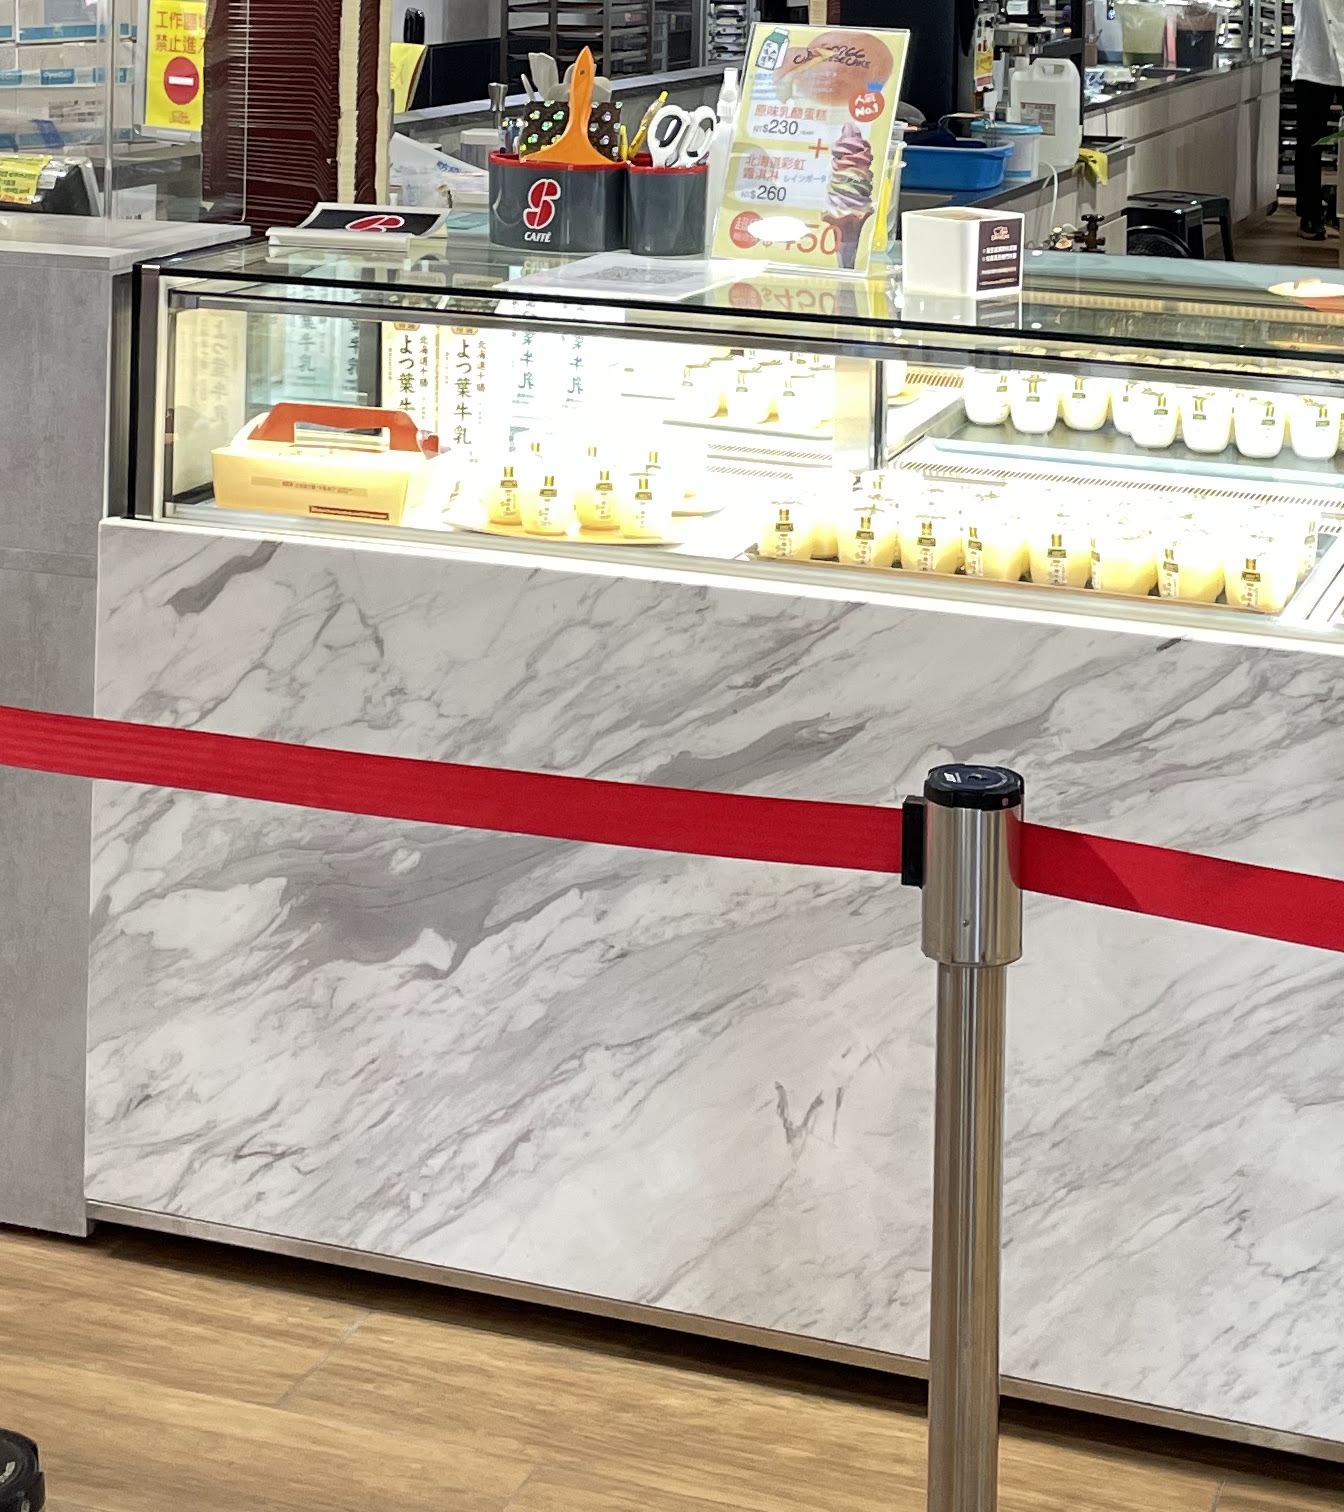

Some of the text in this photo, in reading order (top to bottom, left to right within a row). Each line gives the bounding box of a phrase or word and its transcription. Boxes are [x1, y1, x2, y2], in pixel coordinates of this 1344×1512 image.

[754, 104, 828, 122] 原味乳酪蛋糕
[855, 104, 879, 117] No.1
[745, 155, 805, 172] 北海道彩虹
[453, 339, 473, 445] よつ葉牛乳
